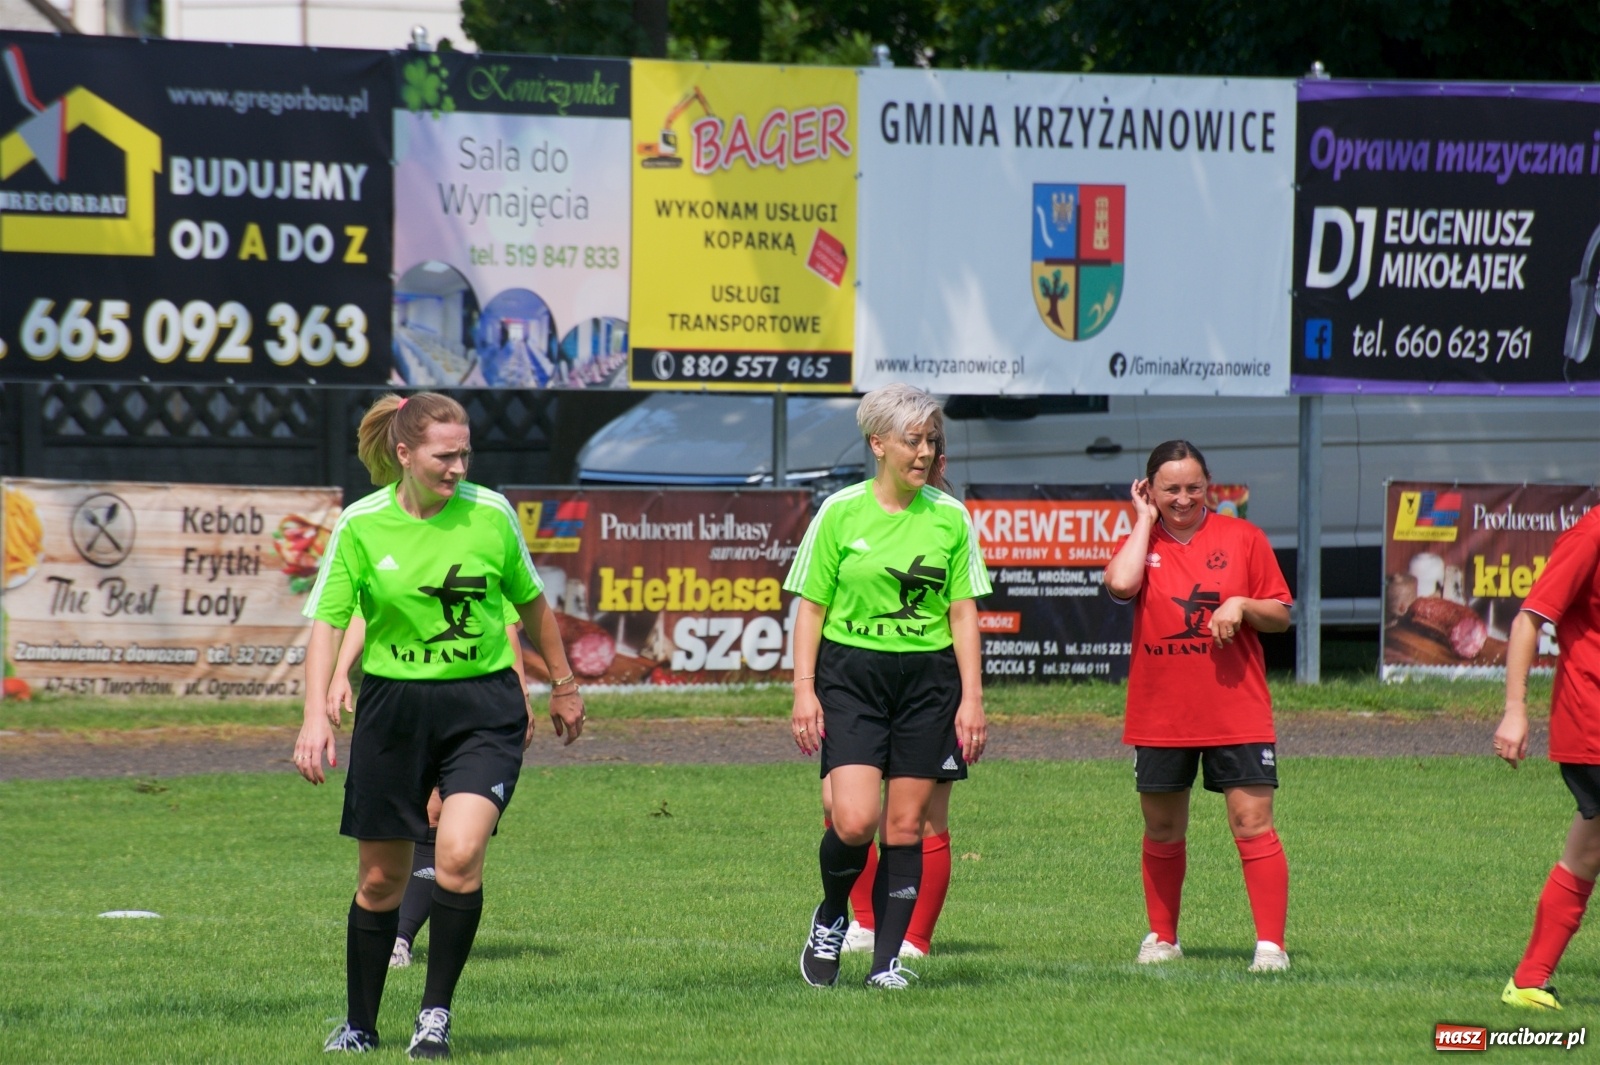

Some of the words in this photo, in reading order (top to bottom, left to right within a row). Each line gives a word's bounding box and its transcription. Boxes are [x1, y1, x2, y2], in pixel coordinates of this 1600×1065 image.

[168, 86, 369, 117] www.gregorbau.pl
[466, 65, 620, 116] Koniczynka
[691, 104, 853, 175] BAGER
[880, 100, 999, 147] GMINA
[1014, 95, 1277, 154] KRZYŻANOWICE
[458, 136, 520, 172] Sala
[531, 140, 568, 173] do
[1309, 125, 1430, 182] Oprawa
[1436, 139, 1584, 185] muzyczna
[1590, 129, 1600, 175] i
[170, 156, 368, 201] BUDUJEMY
[438, 182, 589, 227] Wynajęcia
[655, 199, 758, 220] WYKONAM
[765, 202, 838, 223] USŁUGI
[169, 219, 229, 260] OD
[238, 223, 268, 261] A
[278, 223, 334, 263] DO
[343, 225, 368, 263] Z
[470, 244, 499, 266] tel.
[505, 244, 537, 267] 519
[543, 245, 579, 267] 847
[584, 247, 620, 269] 833
[703, 230, 797, 255] KOPARKĄ
[1305, 206, 1378, 300] DJ
[1384, 207, 1535, 246] EUGENIUSZ
[1378, 252, 1528, 294] MIKOŁAJEK
[711, 285, 780, 304] USŁUGI
[20, 298, 131, 361] 665
[144, 300, 252, 363] 092
[264, 303, 370, 367] 363
[668, 313, 822, 333] TRANSPORTOWE
[1353, 318, 1387, 358] tel.
[1395, 324, 1442, 358] 660
[1447, 325, 1489, 363] 623
[1496, 326, 1532, 363] 761
[681, 355, 728, 377] 880
[734, 355, 779, 378] 557
[786, 357, 831, 378] 965
[874, 354, 1025, 379] www.krzyzanowice.pl
[182, 505, 264, 535] Kebab
[600, 513, 695, 540] Producent
[974, 509, 1134, 543] KREWETKA
[1473, 503, 1556, 532] Producent
[182, 547, 260, 582] Frytki
[982, 546, 1009, 560] KLEP
[1012, 547, 1048, 560] RYBNY
[1068, 544, 1112, 560] SMAŻAL
[47, 576, 90, 615] The
[98, 577, 159, 616] Best
[598, 566, 782, 612] kiełbasa
[182, 588, 248, 623] Lody
[978, 613, 1014, 629] CIBÓRZ
[14, 641, 112, 662] Zamówienia
[112, 646, 122, 663] z
[126, 642, 198, 664] dowozem
[207, 645, 233, 664] tel.
[235, 646, 255, 665] 32
[985, 641, 1041, 656] ZBOROWA
[1144, 643, 1164, 656] Va
[986, 660, 1025, 675] OCICKA
